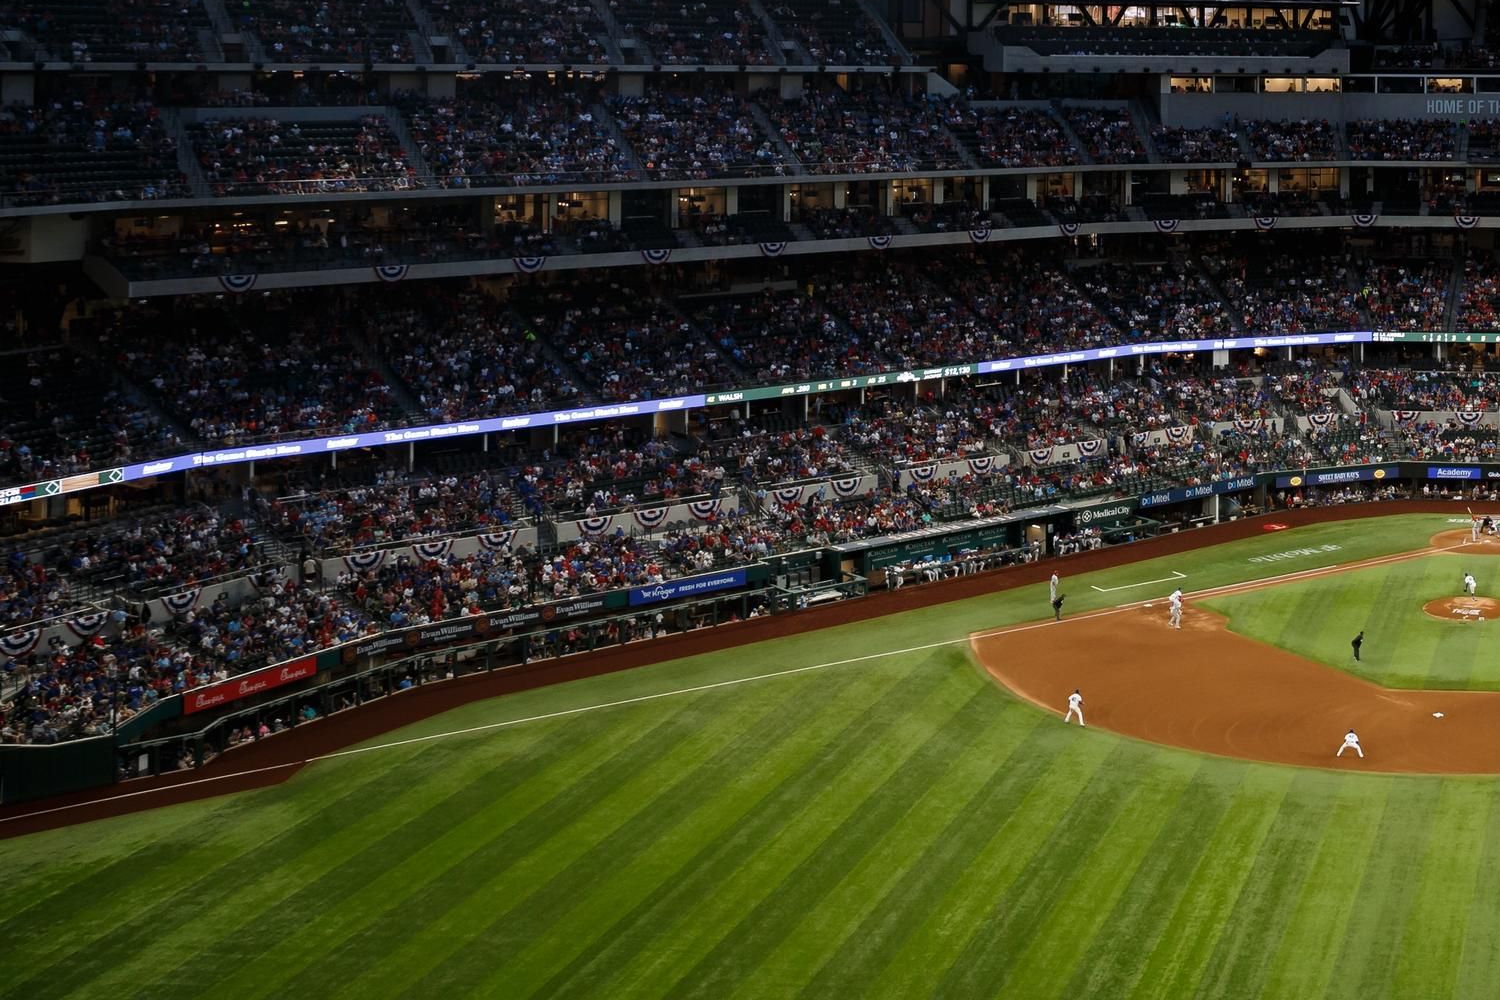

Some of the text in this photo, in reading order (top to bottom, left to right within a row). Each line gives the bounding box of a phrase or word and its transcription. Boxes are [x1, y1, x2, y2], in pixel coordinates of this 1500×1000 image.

[1426, 100, 1463, 114] HOME
[1468, 100, 1484, 114] OF
[718, 392, 743, 402] WALSH
[1318, 473, 1333, 482] SWEET
[1436, 468, 1472, 477] Academy
[1236, 476, 1254, 487] Mitel
[1195, 484, 1213, 495] Mitel
[1151, 492, 1170, 503] Mitel
[1093, 506, 1130, 519] Medical City
[652, 585, 675, 599] Kroger
[679, 584, 695, 592] FRESH
[556, 600, 603, 614] Evan Williams
[490, 612, 539, 626] Evan Williams
[420, 625, 472, 639] Evan Williams
[356, 637, 403, 655] Evan Williams
